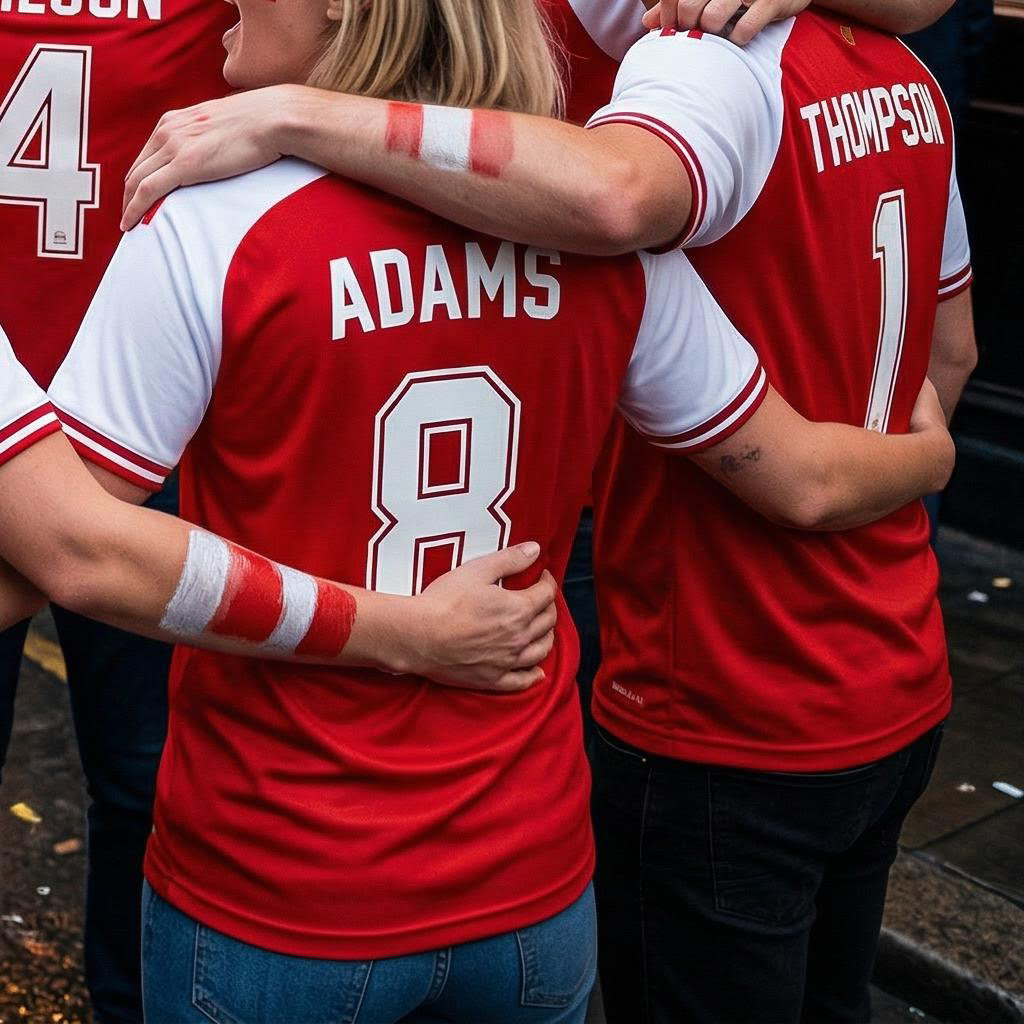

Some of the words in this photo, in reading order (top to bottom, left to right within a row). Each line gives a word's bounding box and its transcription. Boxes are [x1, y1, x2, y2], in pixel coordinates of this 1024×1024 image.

[799, 82, 945, 174] THOMPSON
[329, 241, 561, 341] ADAMS
[864, 188, 909, 435] 1
[365, 364, 522, 598] 8
